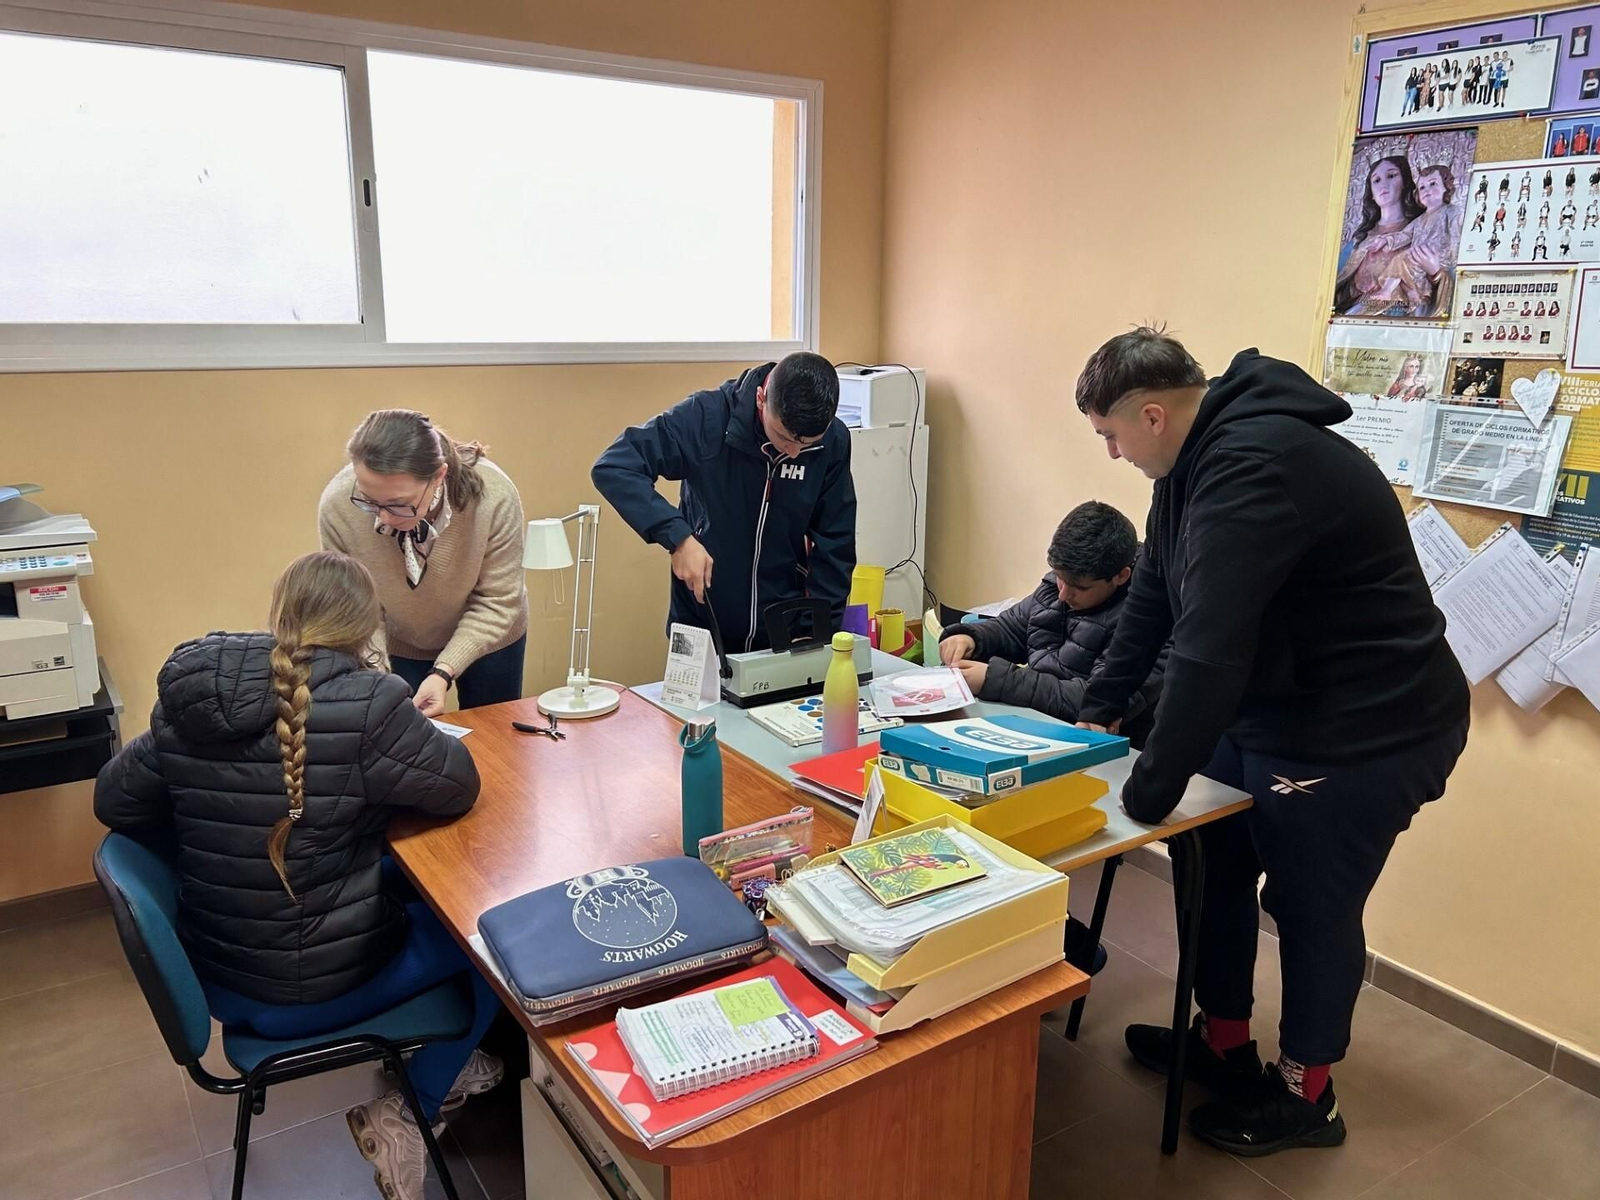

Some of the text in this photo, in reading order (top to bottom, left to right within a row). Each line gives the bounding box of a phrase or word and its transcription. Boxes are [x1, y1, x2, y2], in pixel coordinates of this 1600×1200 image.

[1367, 415, 1392, 424] PREMIO
[1449, 419, 1474, 428] OFERTA
[1485, 423, 1508, 431] CICLOS
[1508, 425, 1551, 435] FORMATIVOS
[1484, 431, 1505, 439] MEDIO
[1505, 432, 1515, 440] EN
[780, 463, 805, 480] HH
[752, 680, 770, 692] FPB
[602, 929, 689, 964] HOGWARTS
[658, 957, 705, 977] HOGWARTS
[592, 975, 641, 996] HOGWARTS
